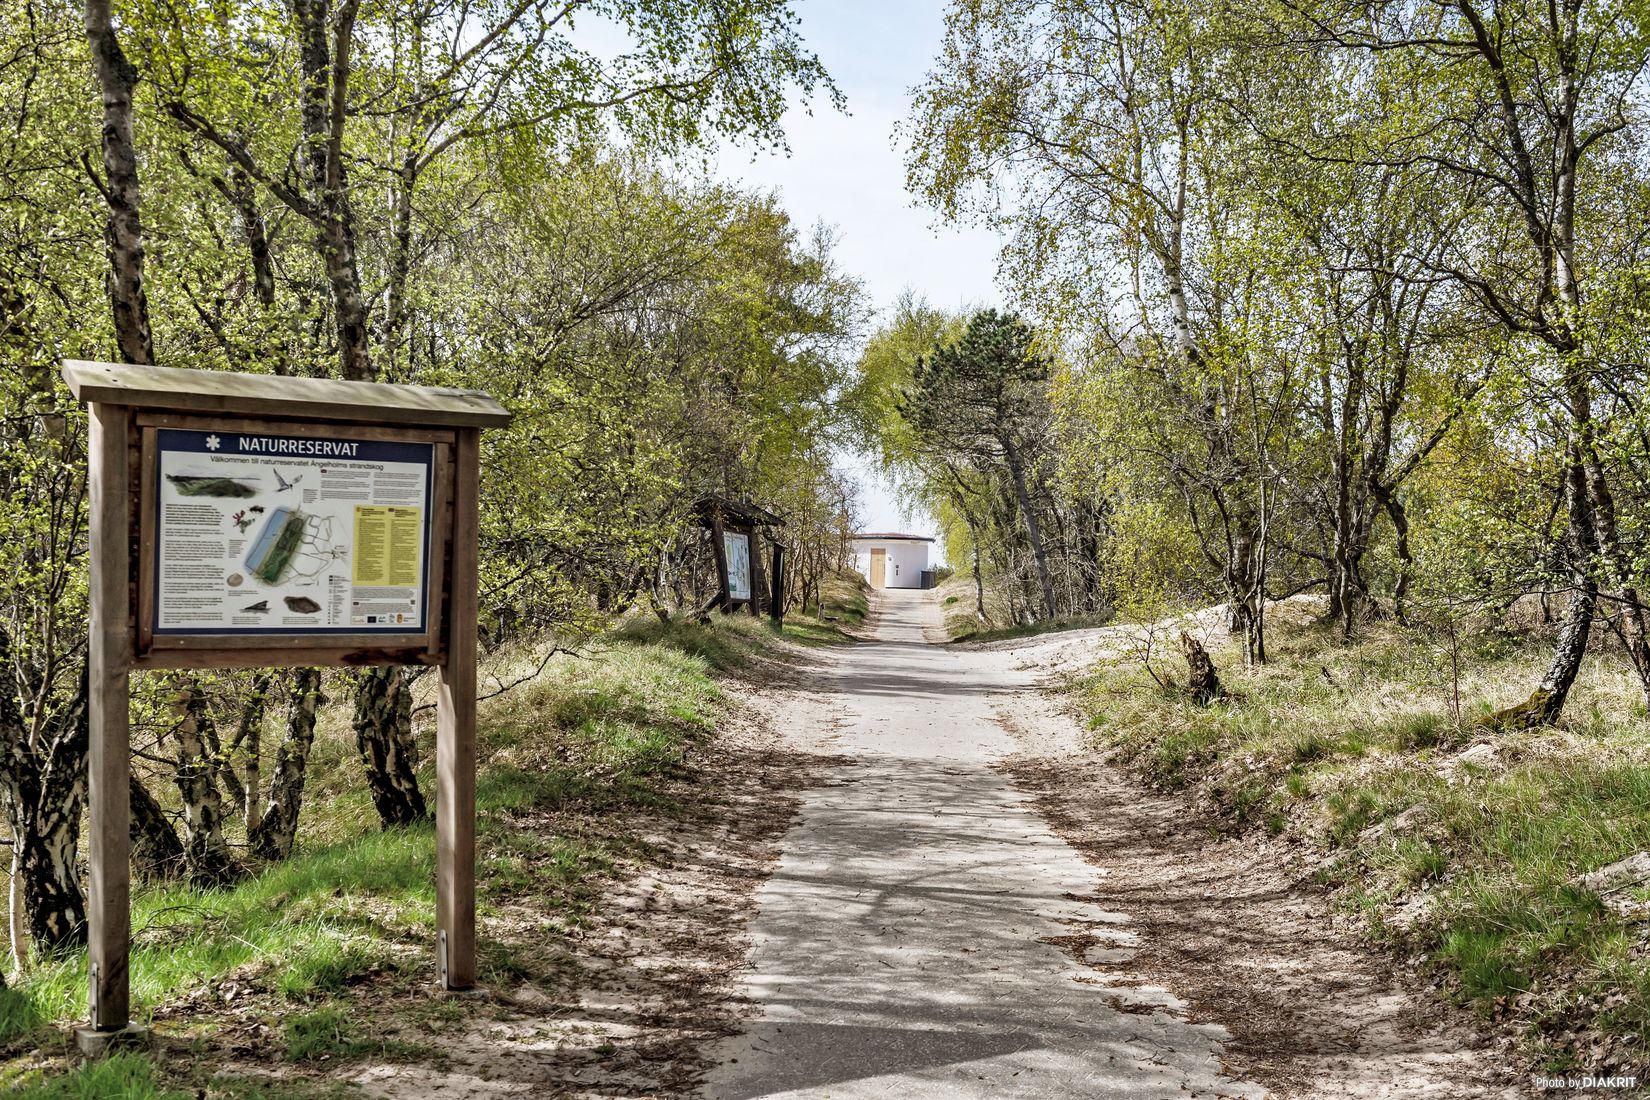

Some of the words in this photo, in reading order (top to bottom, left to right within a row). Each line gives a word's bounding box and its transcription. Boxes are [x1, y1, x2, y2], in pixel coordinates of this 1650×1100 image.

[239, 437, 359, 456] NATURRESERVAT
[210, 455, 250, 463] Välkommen
[260, 458, 309, 466] naturreservatet
